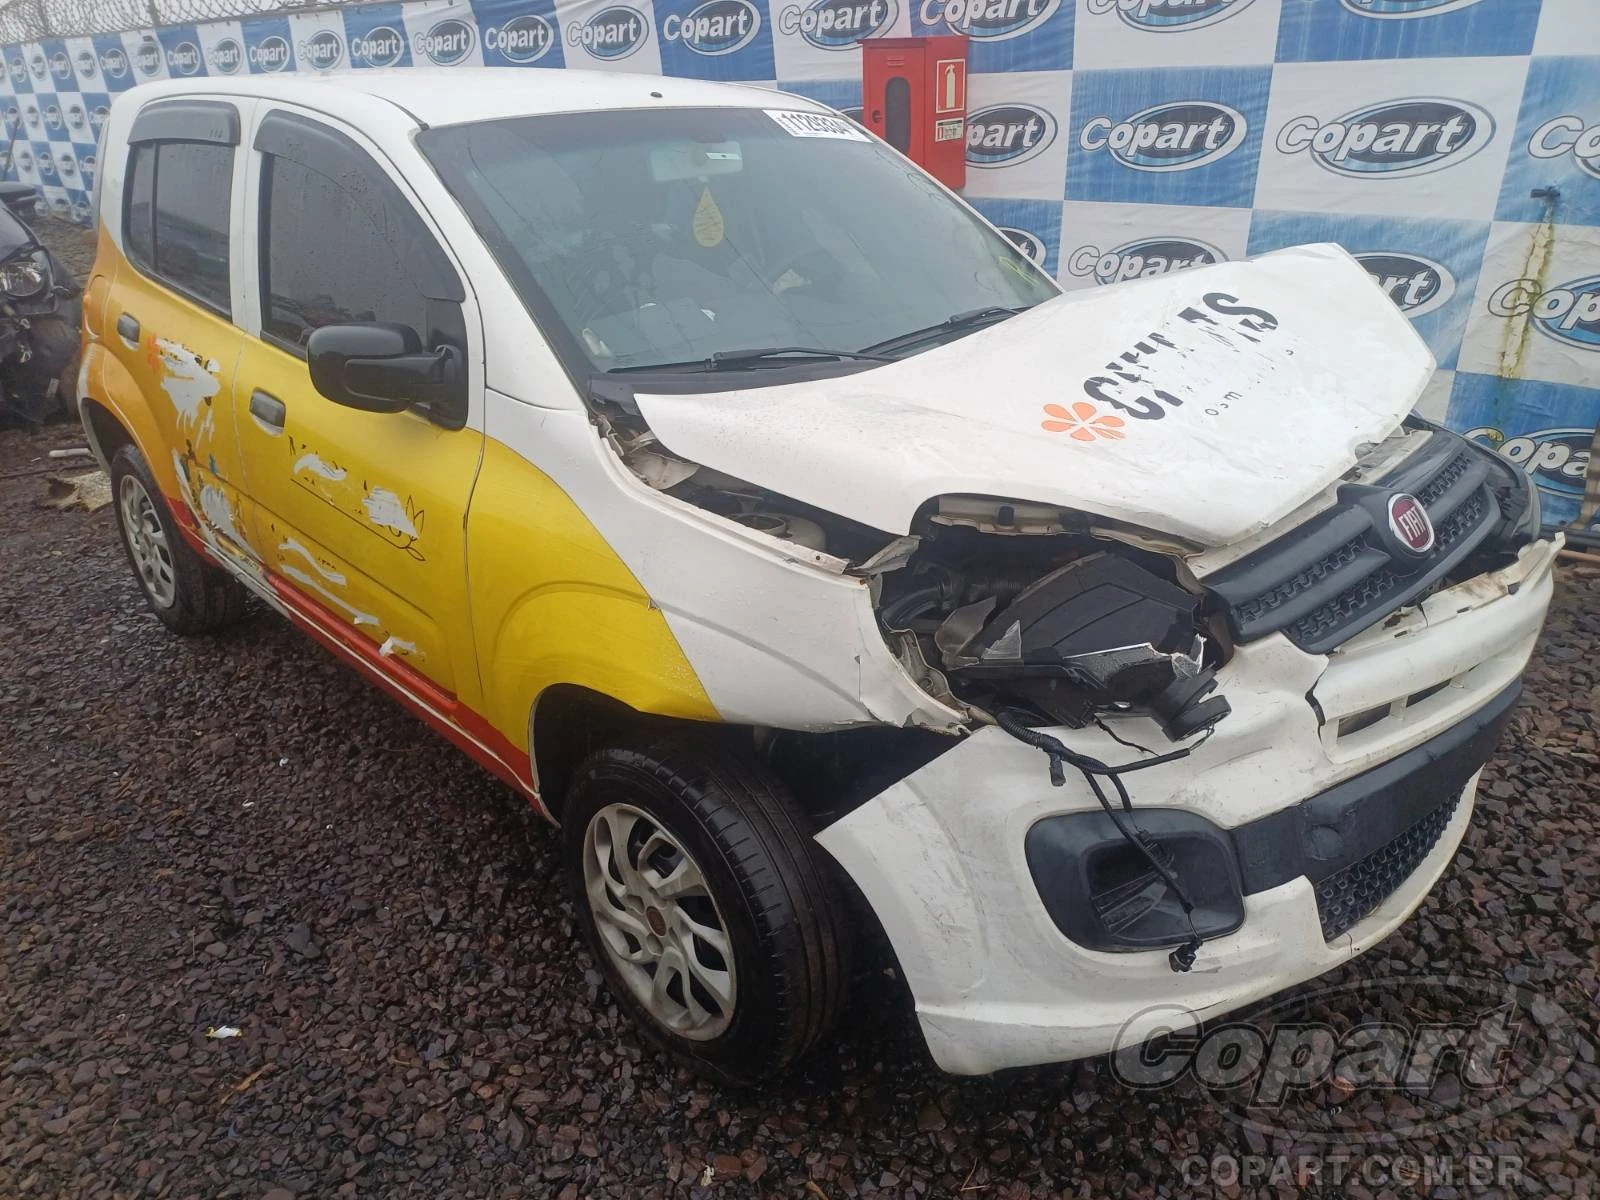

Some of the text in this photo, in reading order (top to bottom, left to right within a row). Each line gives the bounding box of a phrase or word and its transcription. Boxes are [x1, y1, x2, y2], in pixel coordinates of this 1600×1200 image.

[663, 8, 748, 43] Copart
[779, 3, 882, 38] Copart
[919, 0, 1042, 29] Copart
[351, 37, 398, 60] Copart
[414, 29, 467, 57] Copart
[485, 24, 546, 53] Copart
[567, 18, 637, 49] Copart
[249, 43, 286, 66] Copart
[298, 39, 339, 64] Copart
[965, 115, 1038, 152] part
[1079, 114, 1226, 157] Copart
[1275, 115, 1469, 161] Copart
[1398, 505, 1426, 541] FIAT
